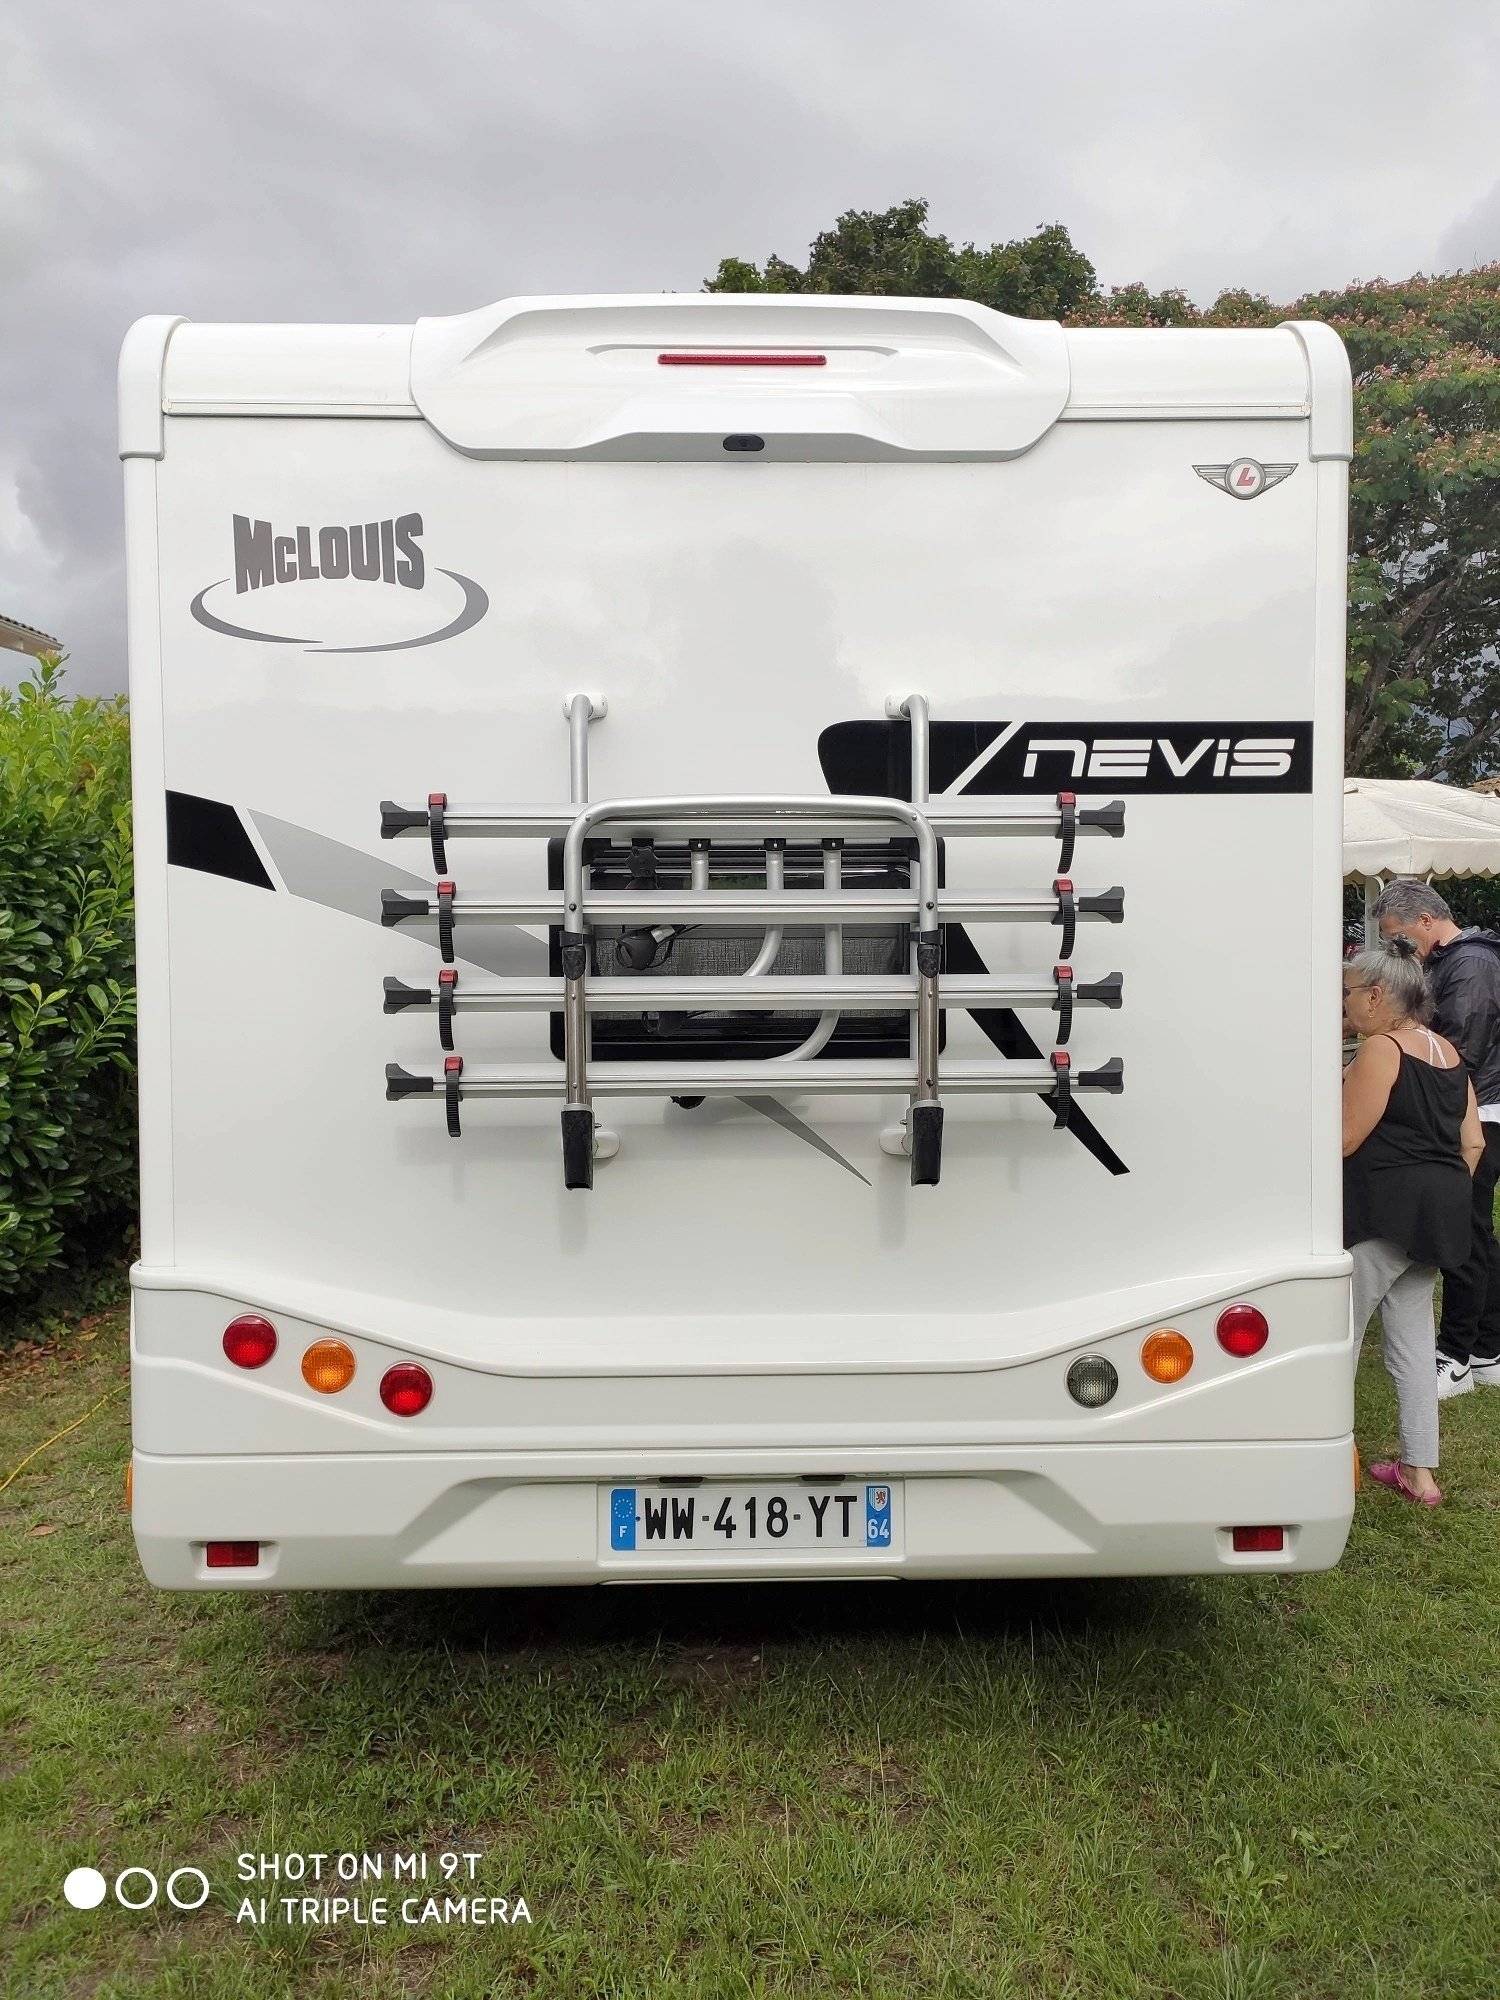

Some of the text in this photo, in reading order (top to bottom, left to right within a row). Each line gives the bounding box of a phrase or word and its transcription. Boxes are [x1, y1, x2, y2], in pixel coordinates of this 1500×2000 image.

[232, 512, 425, 594] McLOUIS
[619, 1525, 628, 1537] F
[644, 1495, 858, 1540] WW-418-YT
[867, 1518, 890, 1539] 64
